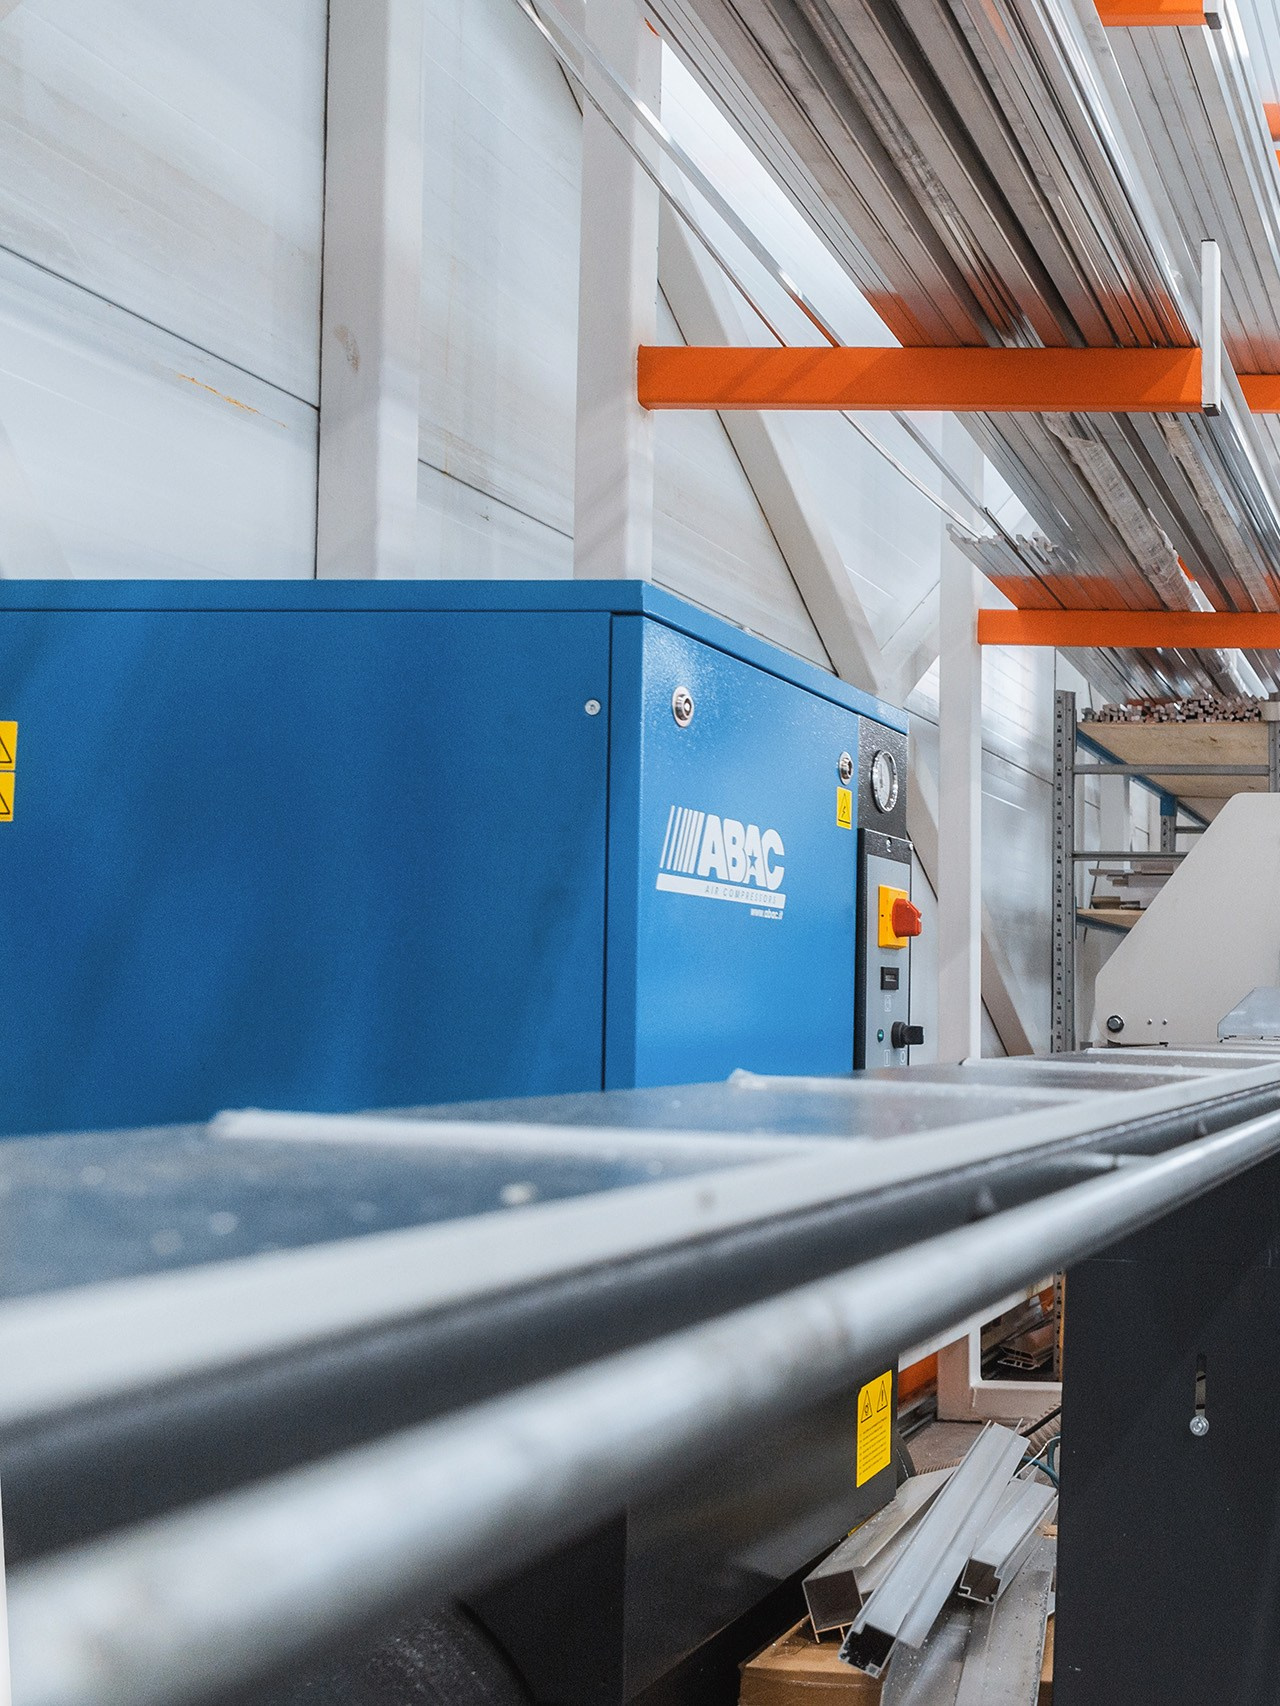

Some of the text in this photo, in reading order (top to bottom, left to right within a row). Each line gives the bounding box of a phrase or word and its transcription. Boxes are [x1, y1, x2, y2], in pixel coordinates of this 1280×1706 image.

[697, 813, 785, 891] ABAC
[704, 884, 777, 905] AIR COMPRESSORS
